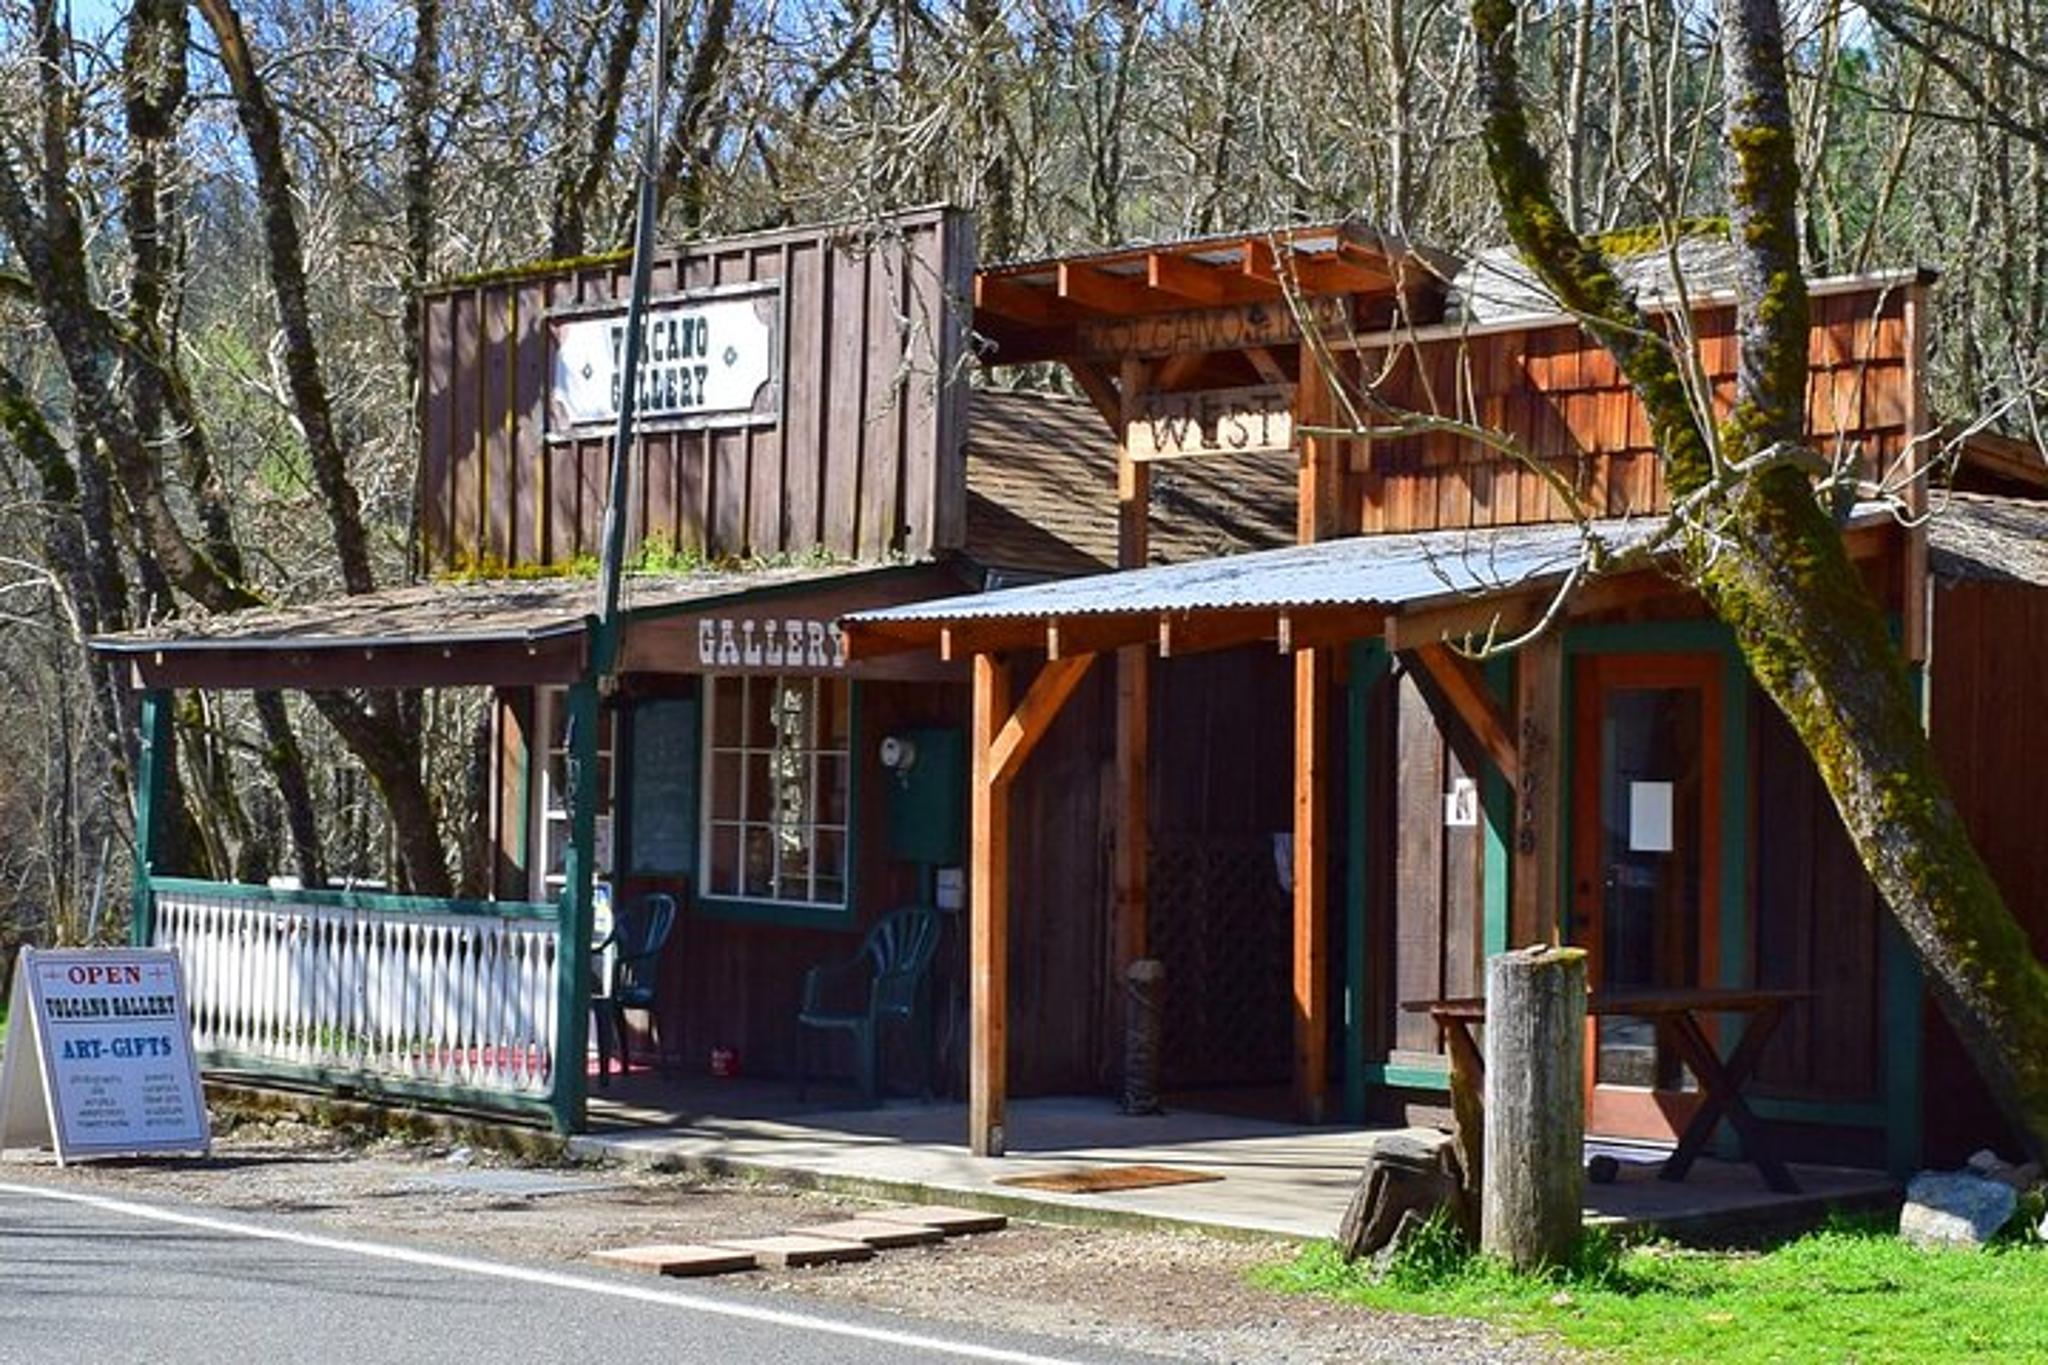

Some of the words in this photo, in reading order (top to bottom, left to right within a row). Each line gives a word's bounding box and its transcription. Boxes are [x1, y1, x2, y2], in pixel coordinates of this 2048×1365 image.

[611, 316, 710, 365] VLCANO
[611, 365, 709, 413] GLLERY
[1146, 394, 1284, 451] WEST
[699, 619, 847, 668] GALLERY
[67, 965, 141, 985] OPEN
[45, 997, 109, 1018] VOLCANO
[112, 995, 174, 1016] GALLERY
[63, 1035, 172, 1059] ART-GIFTS
